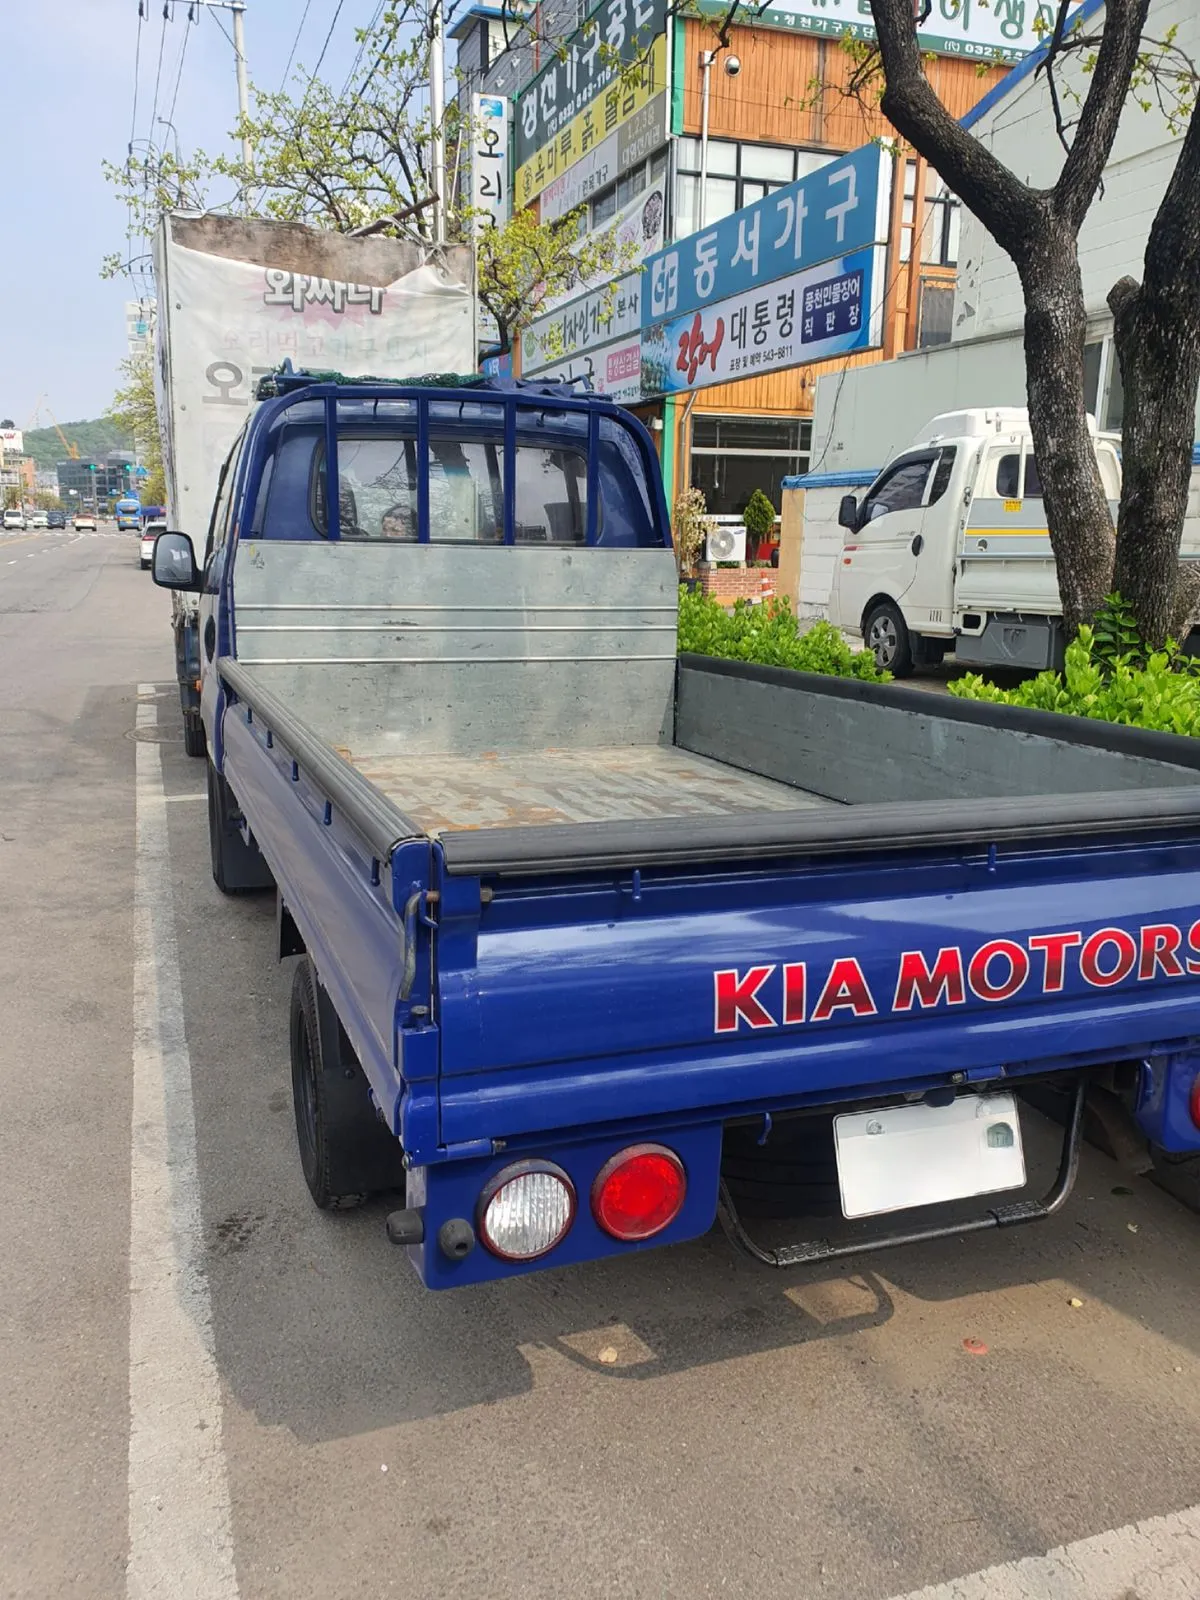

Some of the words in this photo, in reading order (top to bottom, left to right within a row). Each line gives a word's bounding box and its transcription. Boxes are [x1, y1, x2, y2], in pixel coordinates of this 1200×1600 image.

[693, 164, 859, 298] 동서가구
[616, 293, 639, 318] 본사
[729, 289, 796, 350] 대통령
[804, 275, 861, 312] 풍천민물장어
[713, 956, 878, 1034] KIA
